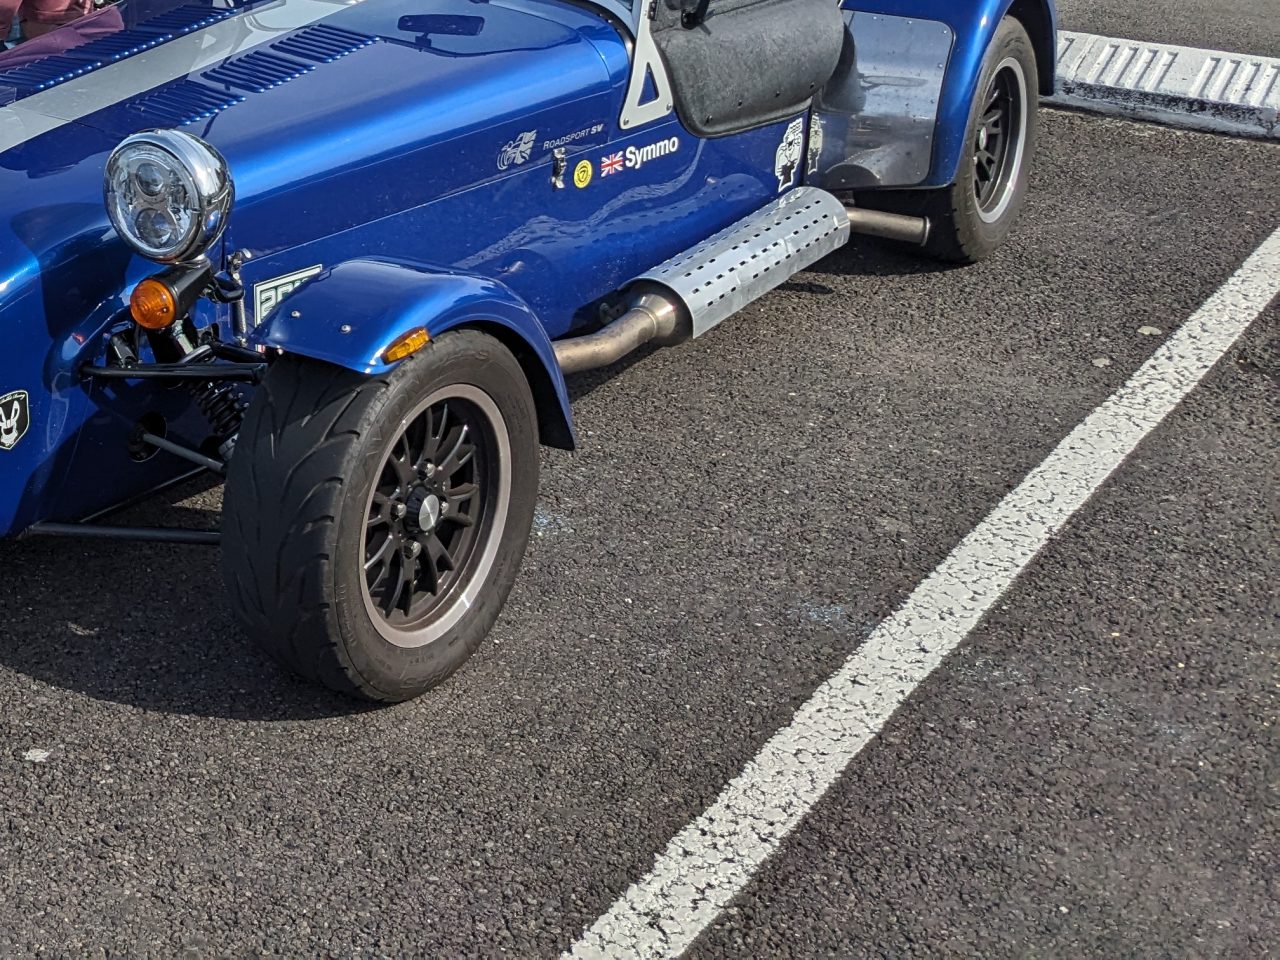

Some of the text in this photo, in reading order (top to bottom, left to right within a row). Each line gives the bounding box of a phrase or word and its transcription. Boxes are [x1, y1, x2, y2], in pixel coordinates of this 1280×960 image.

[543, 123, 604, 151] ROADSPORT SV
[624, 136, 679, 169] Symmo
